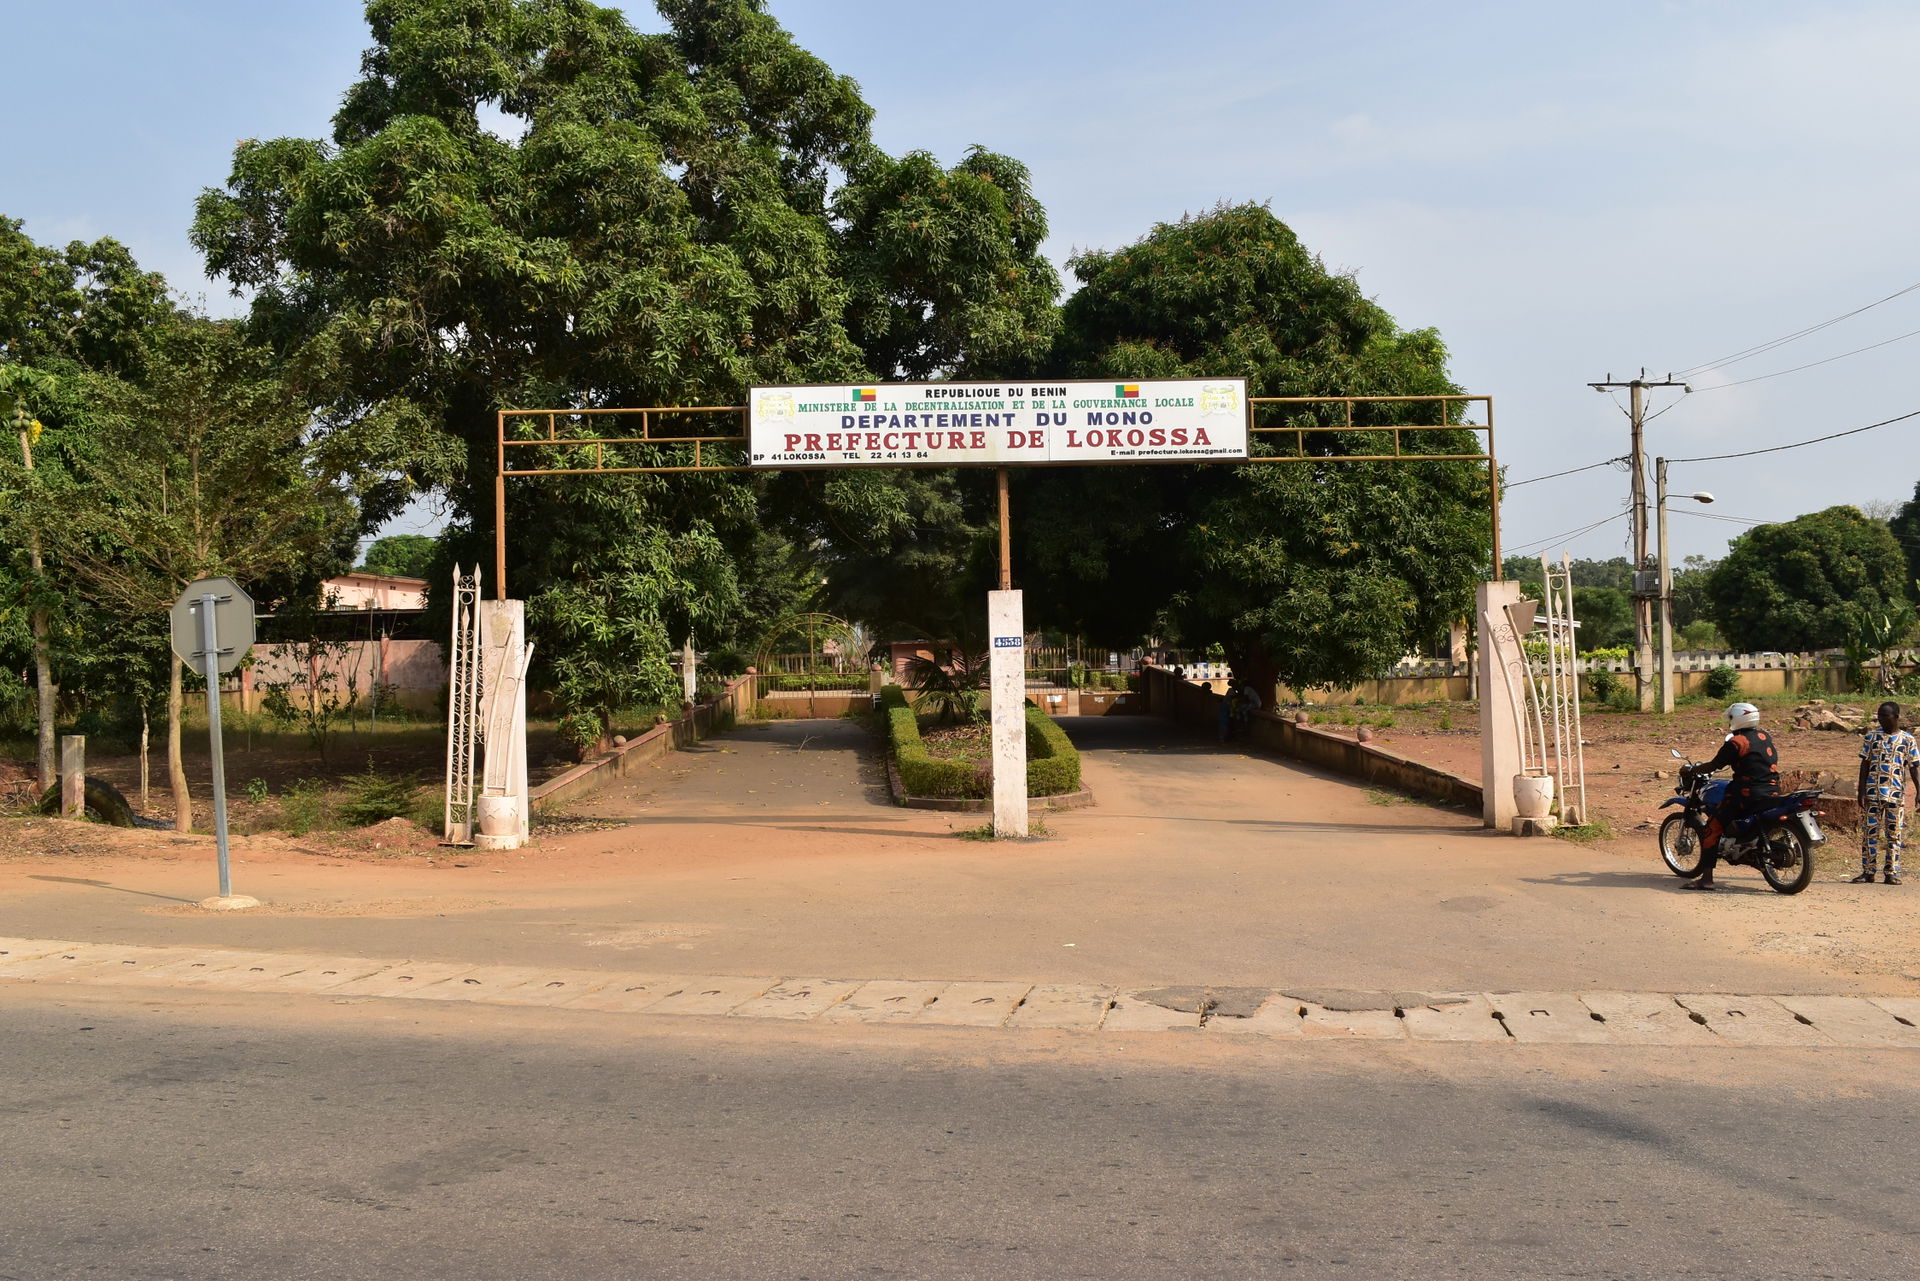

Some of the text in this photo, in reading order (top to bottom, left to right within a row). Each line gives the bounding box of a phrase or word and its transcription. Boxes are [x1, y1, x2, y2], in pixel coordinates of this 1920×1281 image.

[926, 387, 1066, 398] REPUBLIQUE DU BENIN
[799, 398, 1193, 412] MINISTERE DE LA DECENTRALISATION ET DE LA GOUVERNANCE LOCALE
[842, 412, 1152, 428] DEPARTEMENT DU MONO
[784, 428, 1211, 451] PREFECTURE DE LOKOSSA
